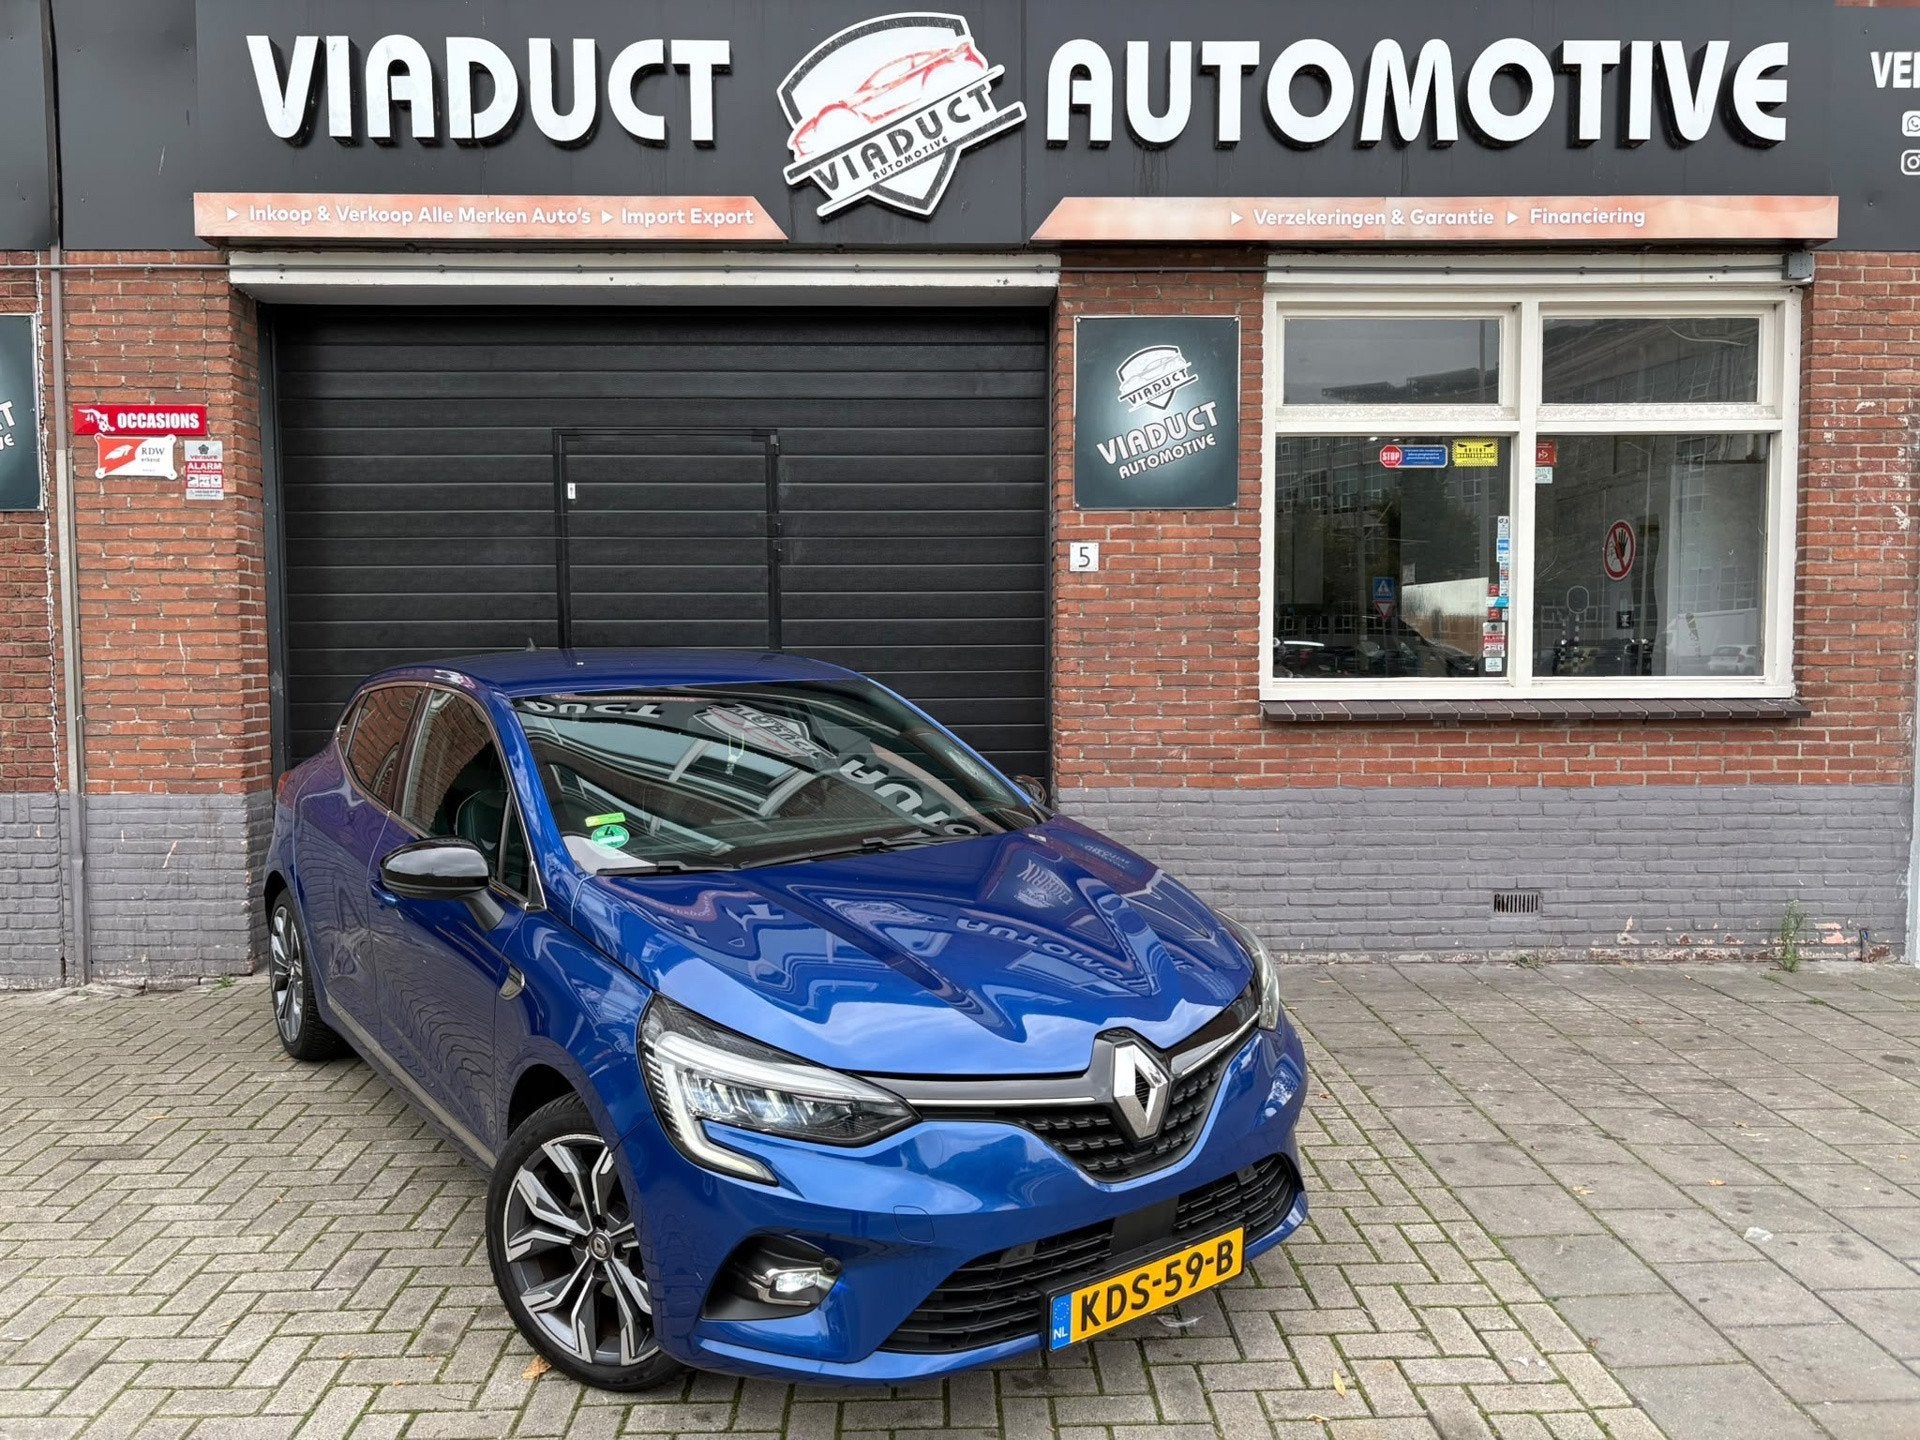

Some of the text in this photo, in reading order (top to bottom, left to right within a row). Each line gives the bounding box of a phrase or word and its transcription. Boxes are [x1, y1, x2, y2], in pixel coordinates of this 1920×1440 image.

[246, 34, 730, 142] VIADUCT
[1047, 37, 1789, 143] AUTOMOTIVE
[814, 83, 991, 191] VIADUCT
[872, 135, 949, 180] AUTOMOTIVE
[249, 205, 591, 226] Inkoop & Verkoop Alle Merken Auto's
[621, 207, 754, 228] Import Export
[1253, 208, 1494, 229] Verzekeringen & Garantie
[1529, 207, 1645, 228] Financiering
[1128, 368, 1187, 405] VIADUCT
[117, 412, 200, 429] OCCASIONS
[1096, 401, 1219, 466] VIADUCT
[188, 462, 222, 470] ALARM
[1118, 433, 1216, 480] AUTOMOTIVE
[1382, 451, 1400, 461] STOP
[1078, 546, 1091, 568] 5
[1081, 1239, 1235, 1332] KDS-59-B
[1053, 1326, 1069, 1340] NL
